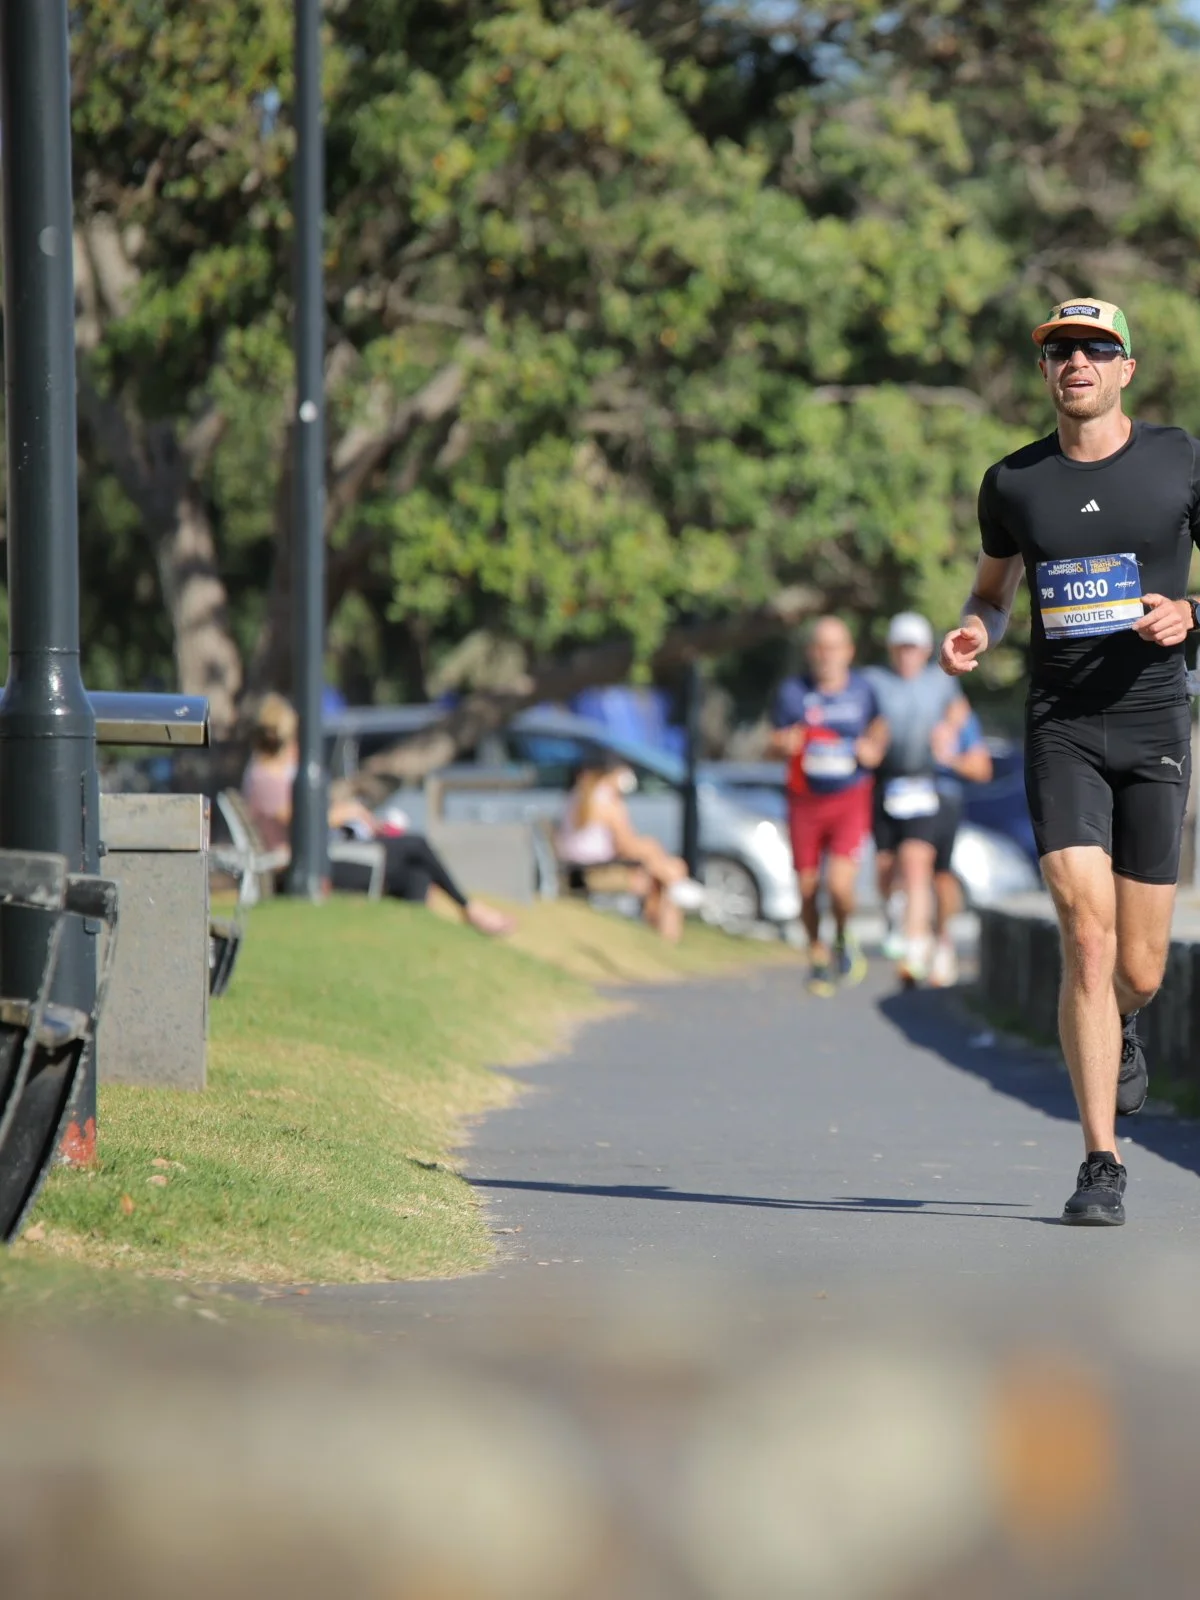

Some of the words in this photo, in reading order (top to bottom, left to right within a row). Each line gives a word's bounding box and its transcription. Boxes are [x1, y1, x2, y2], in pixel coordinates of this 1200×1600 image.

[1053, 562, 1077, 571] BARFOOT
[1090, 560, 1121, 570] TRIATHLON
[1048, 567, 1077, 575] THOMPSON
[1063, 579, 1108, 601] 1030
[1064, 609, 1114, 624] WOUTER
